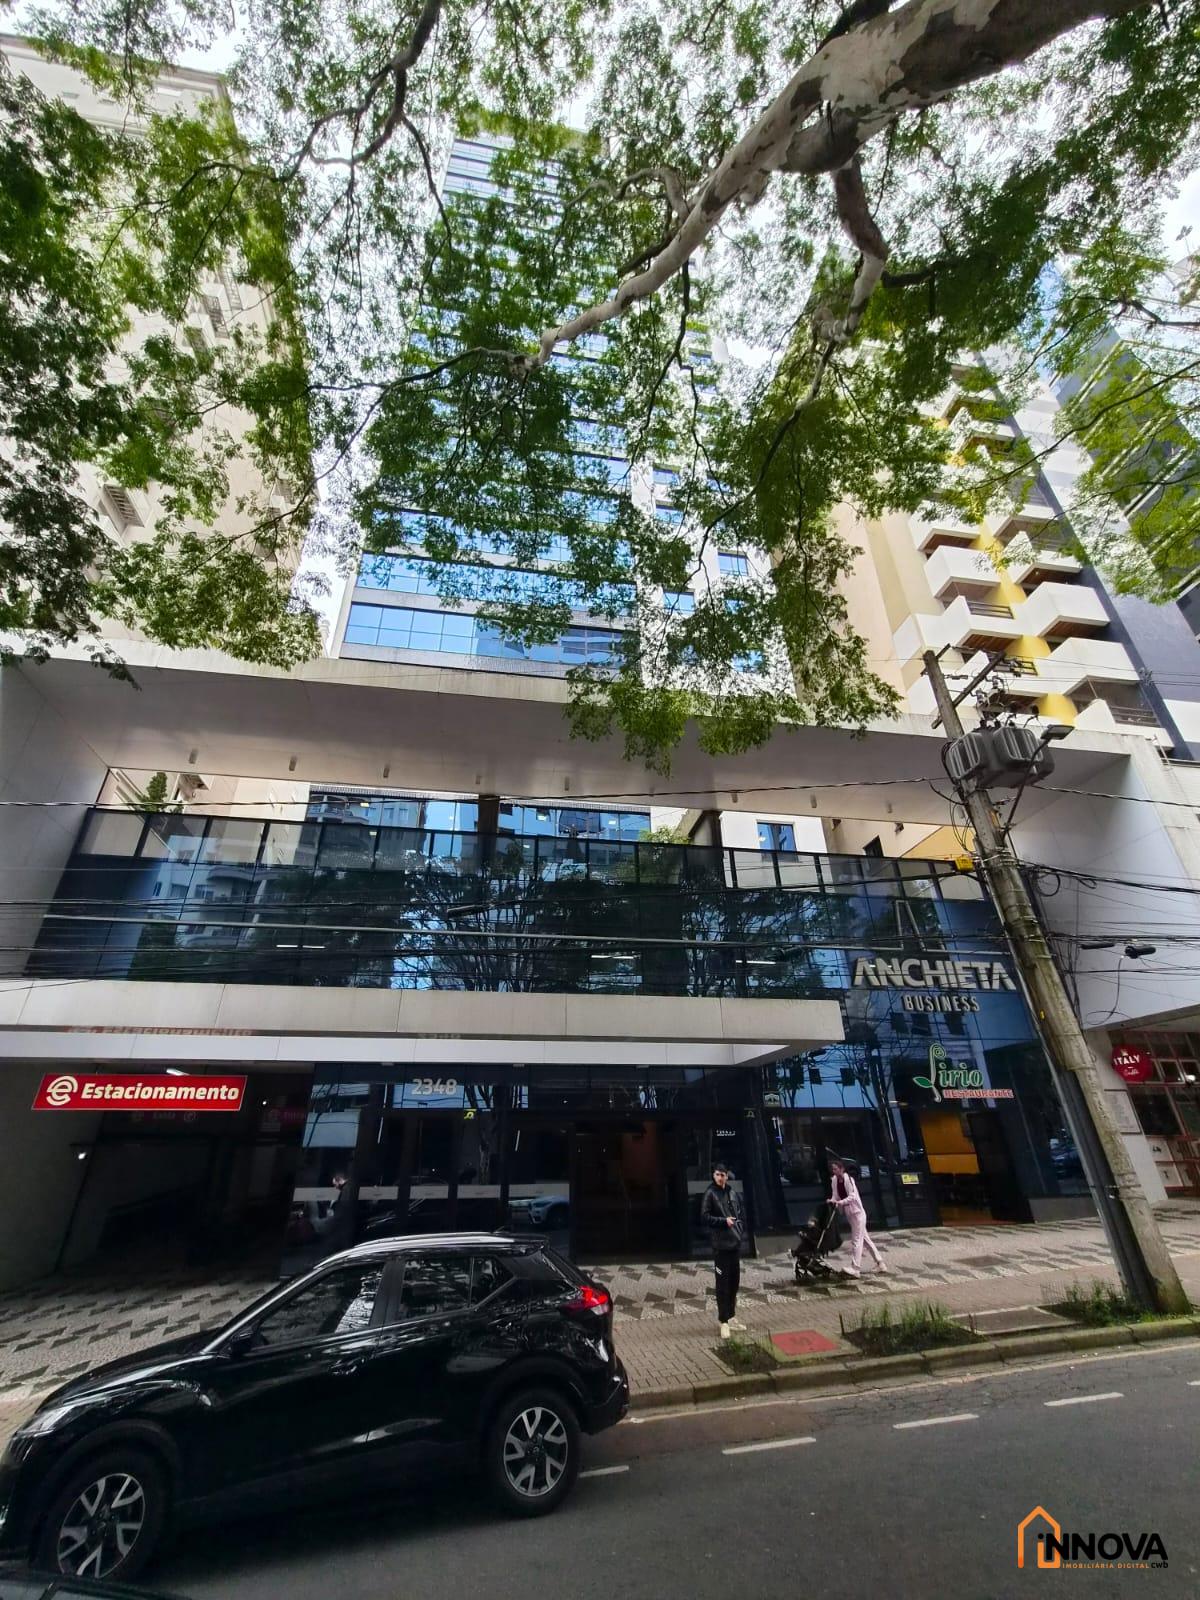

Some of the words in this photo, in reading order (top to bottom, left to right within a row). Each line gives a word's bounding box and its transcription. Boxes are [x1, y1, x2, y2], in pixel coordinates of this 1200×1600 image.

[853, 957, 1017, 990] ANCHIETA
[904, 996, 980, 1012] BUSINESS
[1113, 1055, 1140, 1066] ITALY
[81, 1083, 240, 1100] Estacionamento
[411, 1078, 458, 1095] 2348
